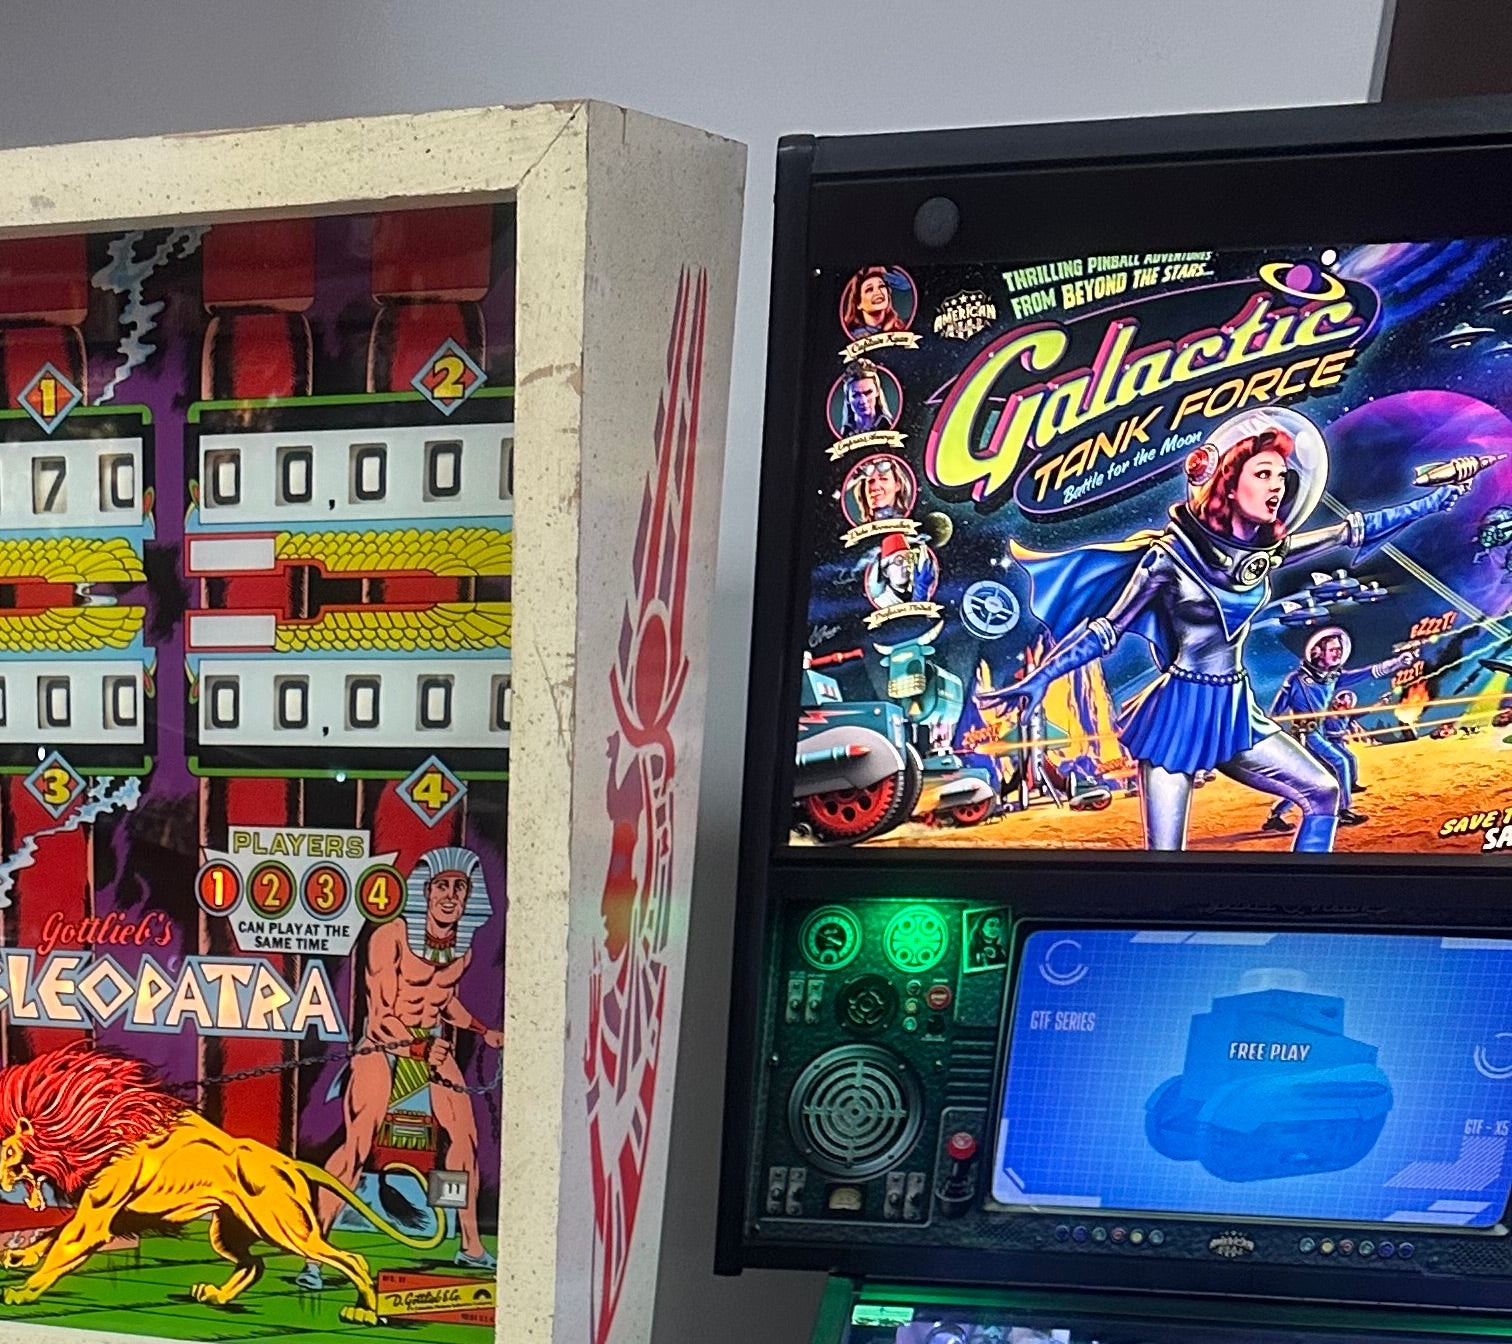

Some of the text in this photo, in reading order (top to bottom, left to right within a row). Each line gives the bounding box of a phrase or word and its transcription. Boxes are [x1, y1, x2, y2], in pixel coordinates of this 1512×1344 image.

[1002, 253, 1140, 292] THRILLING PINBALL
[1010, 293, 1057, 320] FROM
[1061, 273, 1128, 310] BEYOND
[1132, 267, 1159, 288] THE
[933, 302, 998, 333] AMERICAN
[431, 356, 466, 399] 2
[39, 377, 56, 418] 1
[928, 294, 1361, 500] Galactic
[1034, 348, 1358, 503] TANK FORCE
[1063, 430, 1203, 506] Battle for the Moon
[42, 768, 71, 805] 3
[412, 772, 449, 809] 4
[1439, 811, 1499, 837] SAVE
[232, 830, 365, 859] PLAYERS
[212, 871, 389, 910] 1 2 3 4
[37, 911, 173, 956] Gottlieb's
[238, 921, 351, 938] CAN PLAY AT THE
[254, 935, 330, 951] SAME TIME
[1029, 1010, 1095, 1033] GTF SERIES
[1228, 1042, 1312, 1063] FREE PLAY
[1464, 1119, 1485, 1135] GTF
